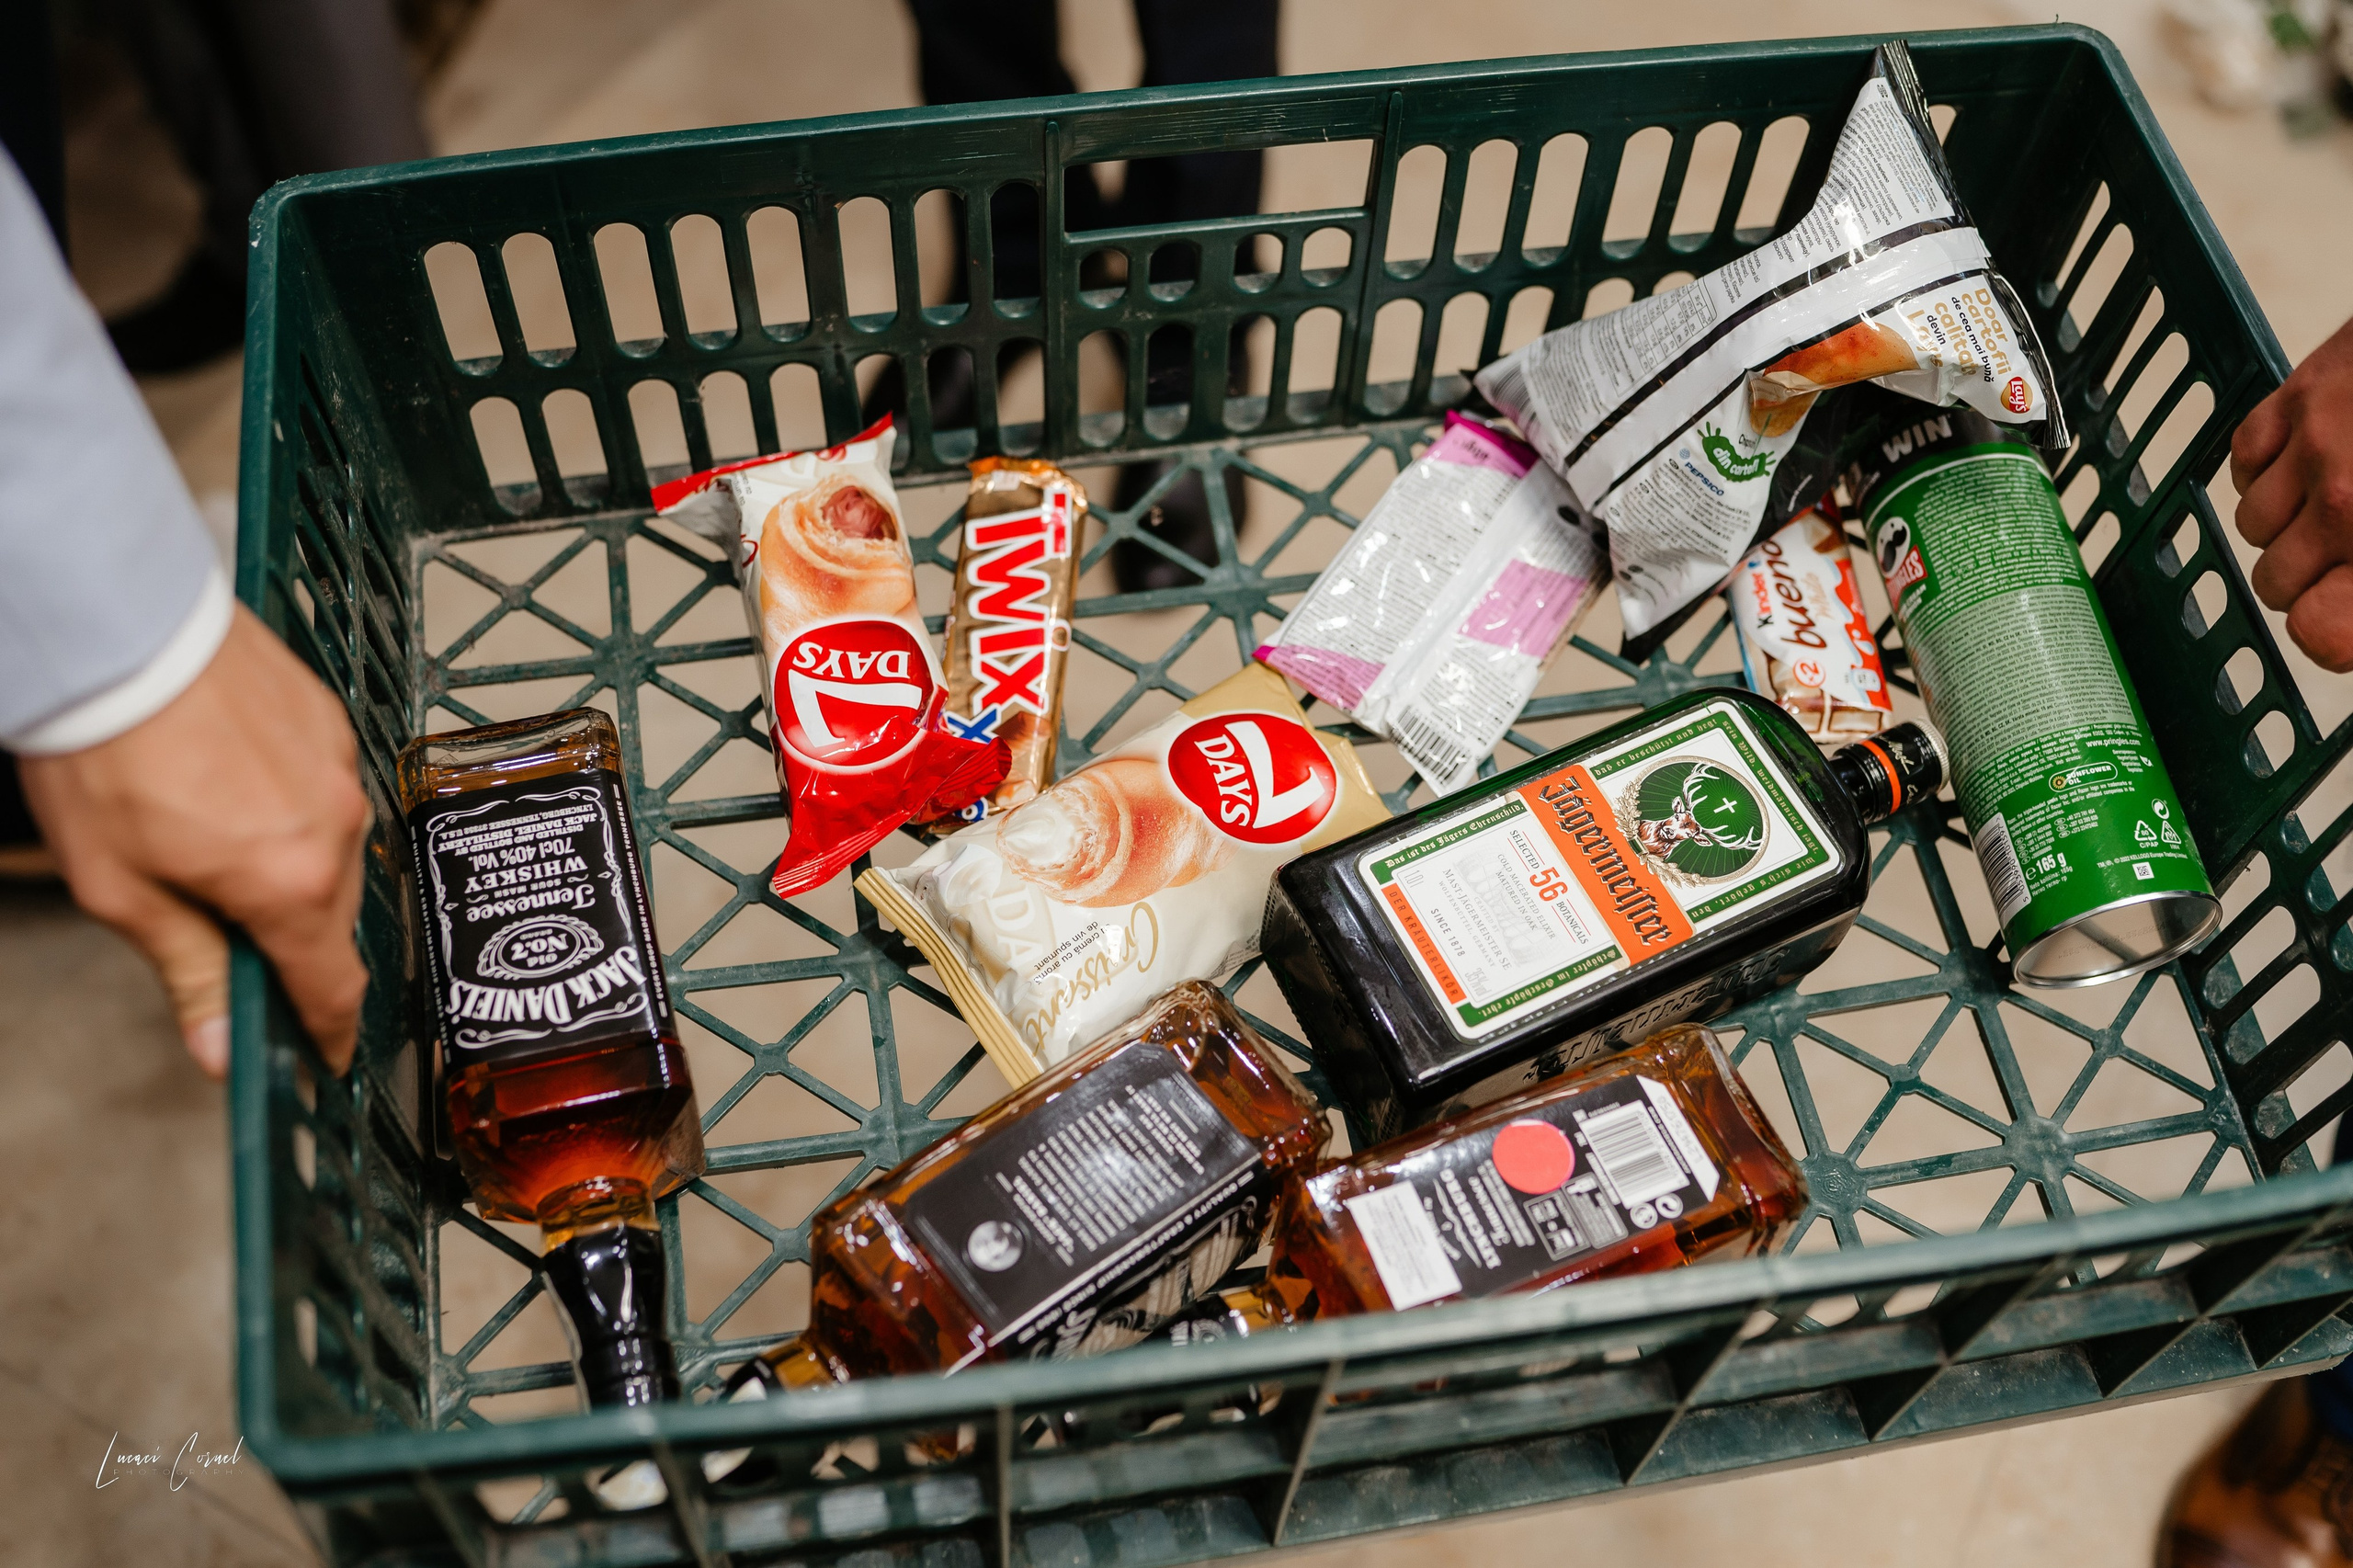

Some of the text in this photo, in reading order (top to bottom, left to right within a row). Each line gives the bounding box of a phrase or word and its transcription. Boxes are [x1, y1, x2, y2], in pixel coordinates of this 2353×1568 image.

[1927, 314, 1946, 345] devin
[1961, 292, 2011, 375] cartofii
[1973, 287, 2008, 342] Doar
[1950, 296, 1994, 381] de cea mai bună
[2004, 376, 2030, 414] Lay's
[1712, 447, 1732, 469] din
[1882, 415, 1952, 462] WIN
[1684, 461, 1724, 495] PEPSICO
[1759, 539, 1827, 646] bueno
[789, 641, 923, 748] DAYS 7
[1722, 720, 1737, 739] sein
[2086, 737, 2140, 746] www.pringles.com
[1194, 733, 1253, 828] DAYS
[1225, 721, 1325, 829] 7
[2065, 765, 2111, 780] SUNFLOWER
[2068, 777, 2081, 785] OIL
[437, 812, 597, 852] JACK DANIEL DISTILLERY
[454, 824, 584, 856] DISTILLED AND BOTTLED BY
[616, 800, 631, 849] TENNESSEE
[464, 855, 587, 893] WHISKEY
[467, 836, 575, 871] 70cl 40% Vol.
[1541, 775, 1671, 942] Jägermeister
[2035, 852, 2066, 874] 165 g
[494, 878, 561, 898] SOUR MASH
[626, 851, 642, 903] LYNCHBURG
[1496, 853, 1555, 939] COLD MACERATED ELIXIR
[1509, 829, 1588, 944] SELECTED 56 BOTANICALS
[466, 883, 596, 922] Tennessee
[1442, 868, 1511, 970] MAST-JÄGERMEISTER SE
[1495, 870, 1520, 904] MATURED
[1524, 915, 1538, 930] OAK
[510, 933, 568, 960] No.7
[1033, 921, 1097, 971] de vin spumant
[1073, 931, 1099, 955] cremă
[1388, 891, 1458, 996] DER KRÄUTERLIKÖR
[1430, 907, 1451, 934] SINCE
[1448, 936, 1465, 956] 1878
[526, 952, 557, 967] Old
[1061, 951, 1073, 962] cu
[445, 945, 646, 1024] JACK DANIEL'S
